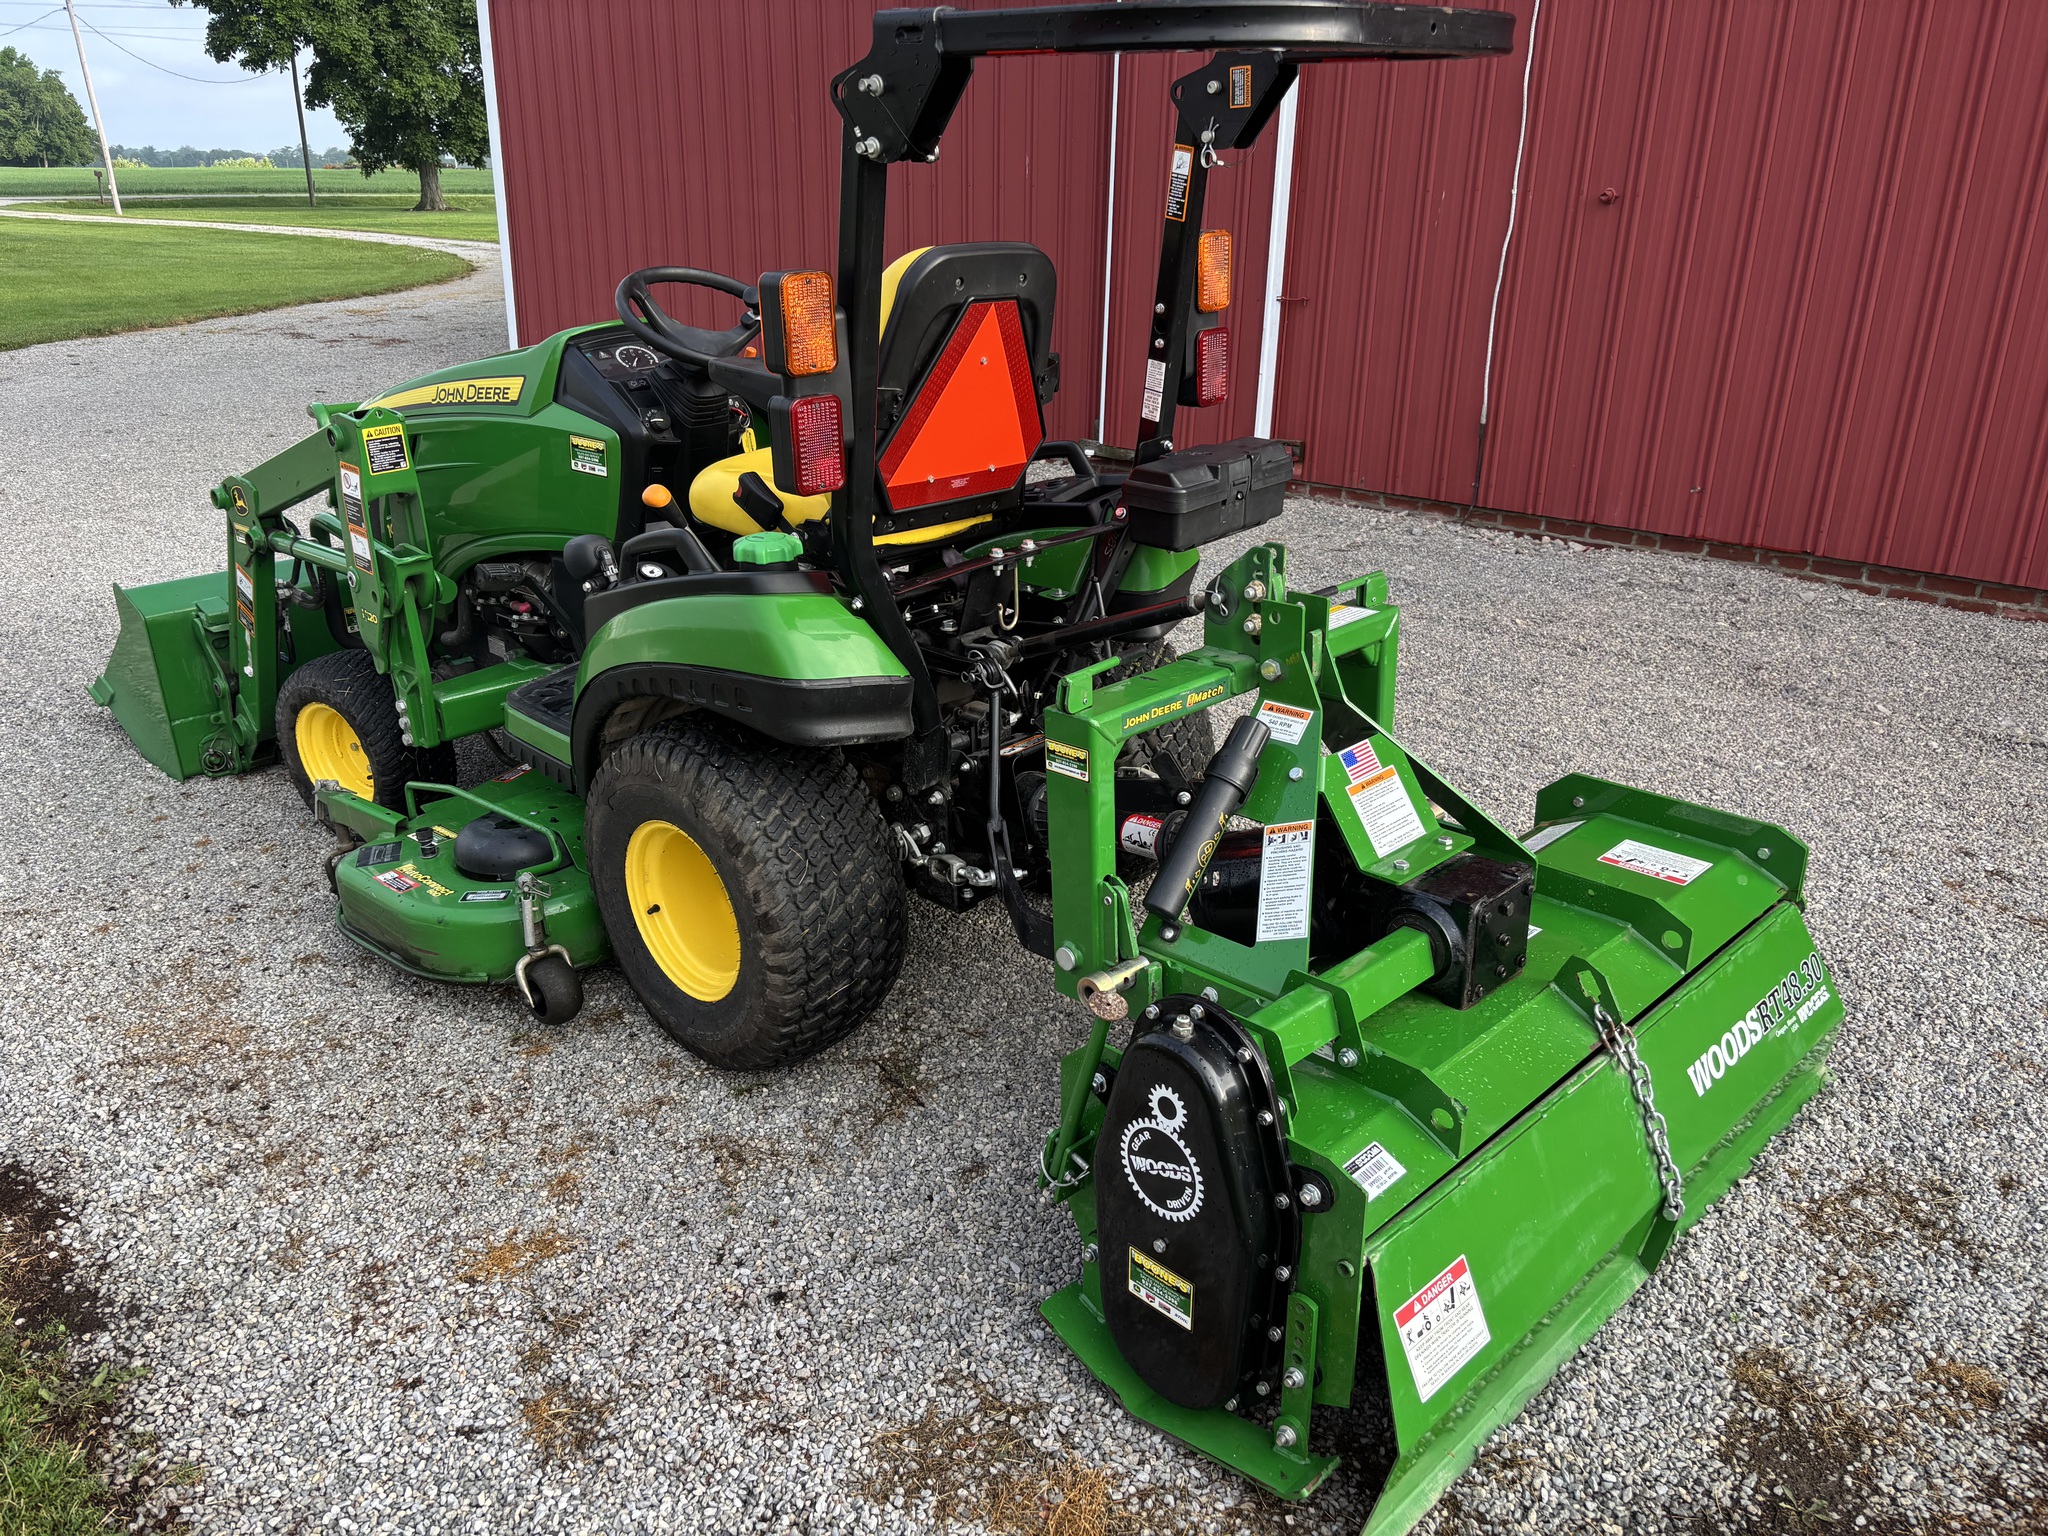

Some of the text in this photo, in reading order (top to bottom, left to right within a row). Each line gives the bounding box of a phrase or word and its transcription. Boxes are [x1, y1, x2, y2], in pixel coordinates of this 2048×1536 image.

[432, 385, 510, 402] JOHN DEERE
[374, 426, 401, 436] CAUTION
[1124, 712, 1150, 729] JOHN
[1151, 701, 1183, 719] DEERE
[1276, 706, 1305, 718] WARNING
[1279, 721, 1292, 729] RPM
[1048, 742, 1085, 760] BOONE'S
[1365, 775, 1384, 787] WARNING
[1137, 818, 1162, 828] DANGER
[1277, 824, 1308, 833] WARNING
[1618, 861, 1656, 876] DANGER
[1796, 985, 1830, 1023] WOODS
[1686, 951, 1824, 1098] WOODS RT48.30
[1131, 1131, 1152, 1151] GEAR
[1353, 1145, 1381, 1167] WOODS
[1130, 1155, 1192, 1182] WOODS
[1166, 1186, 1193, 1209] DRIVEN
[1134, 1252, 1188, 1294] BOONE'S
[1421, 1272, 1454, 1304] DANGER
